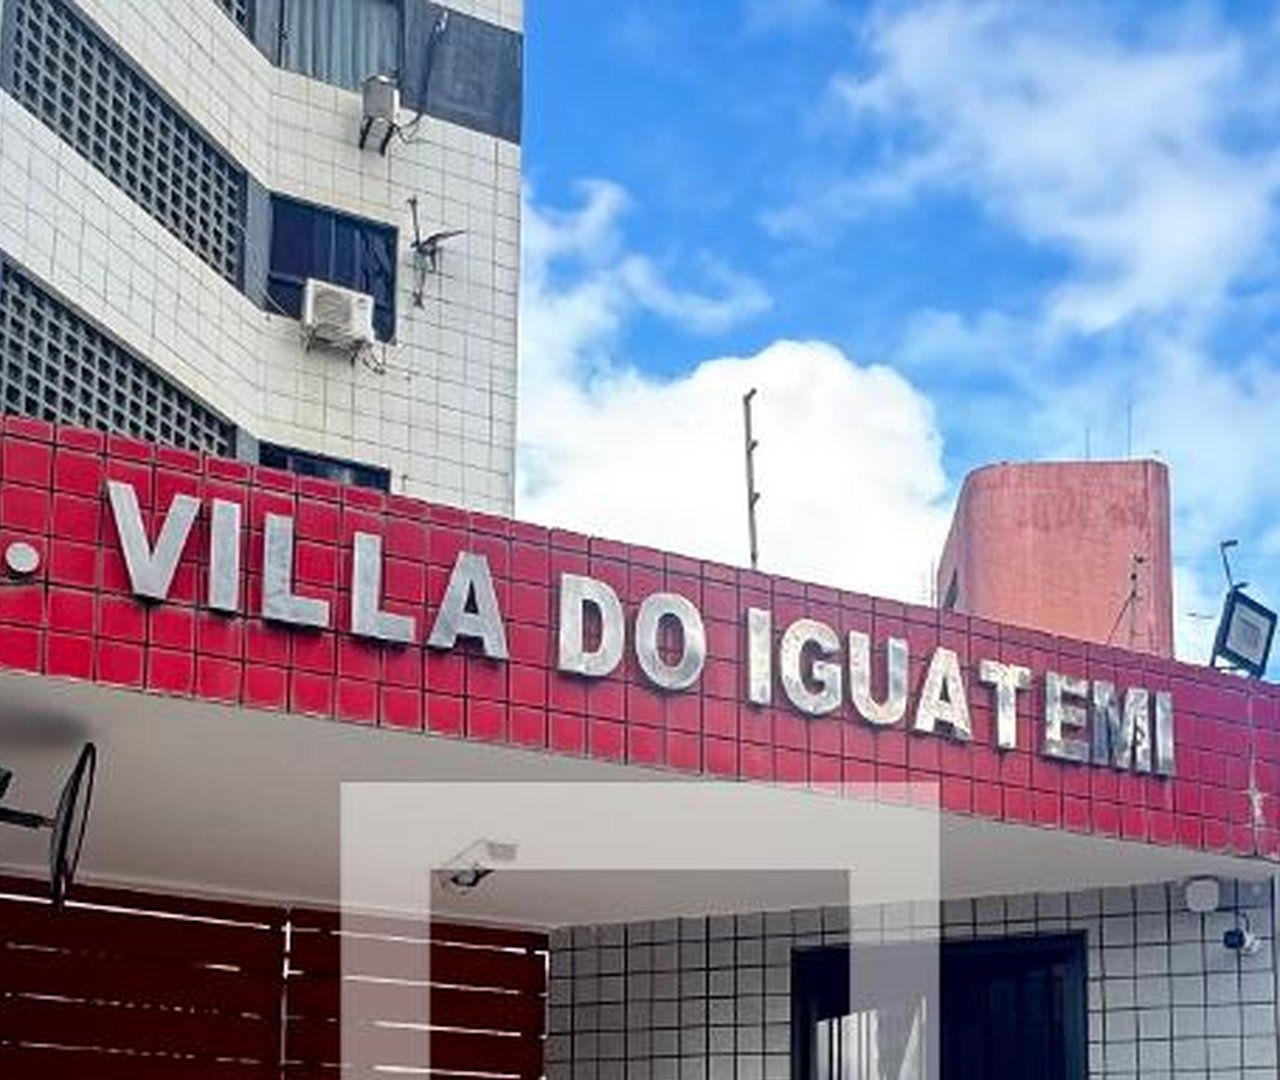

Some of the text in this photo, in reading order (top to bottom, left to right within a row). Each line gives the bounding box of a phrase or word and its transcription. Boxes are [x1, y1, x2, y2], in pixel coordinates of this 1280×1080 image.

[107, 479, 510, 660] VILLA
[558, 573, 707, 692] DO
[748, 607, 1176, 777] IGUATEMI
